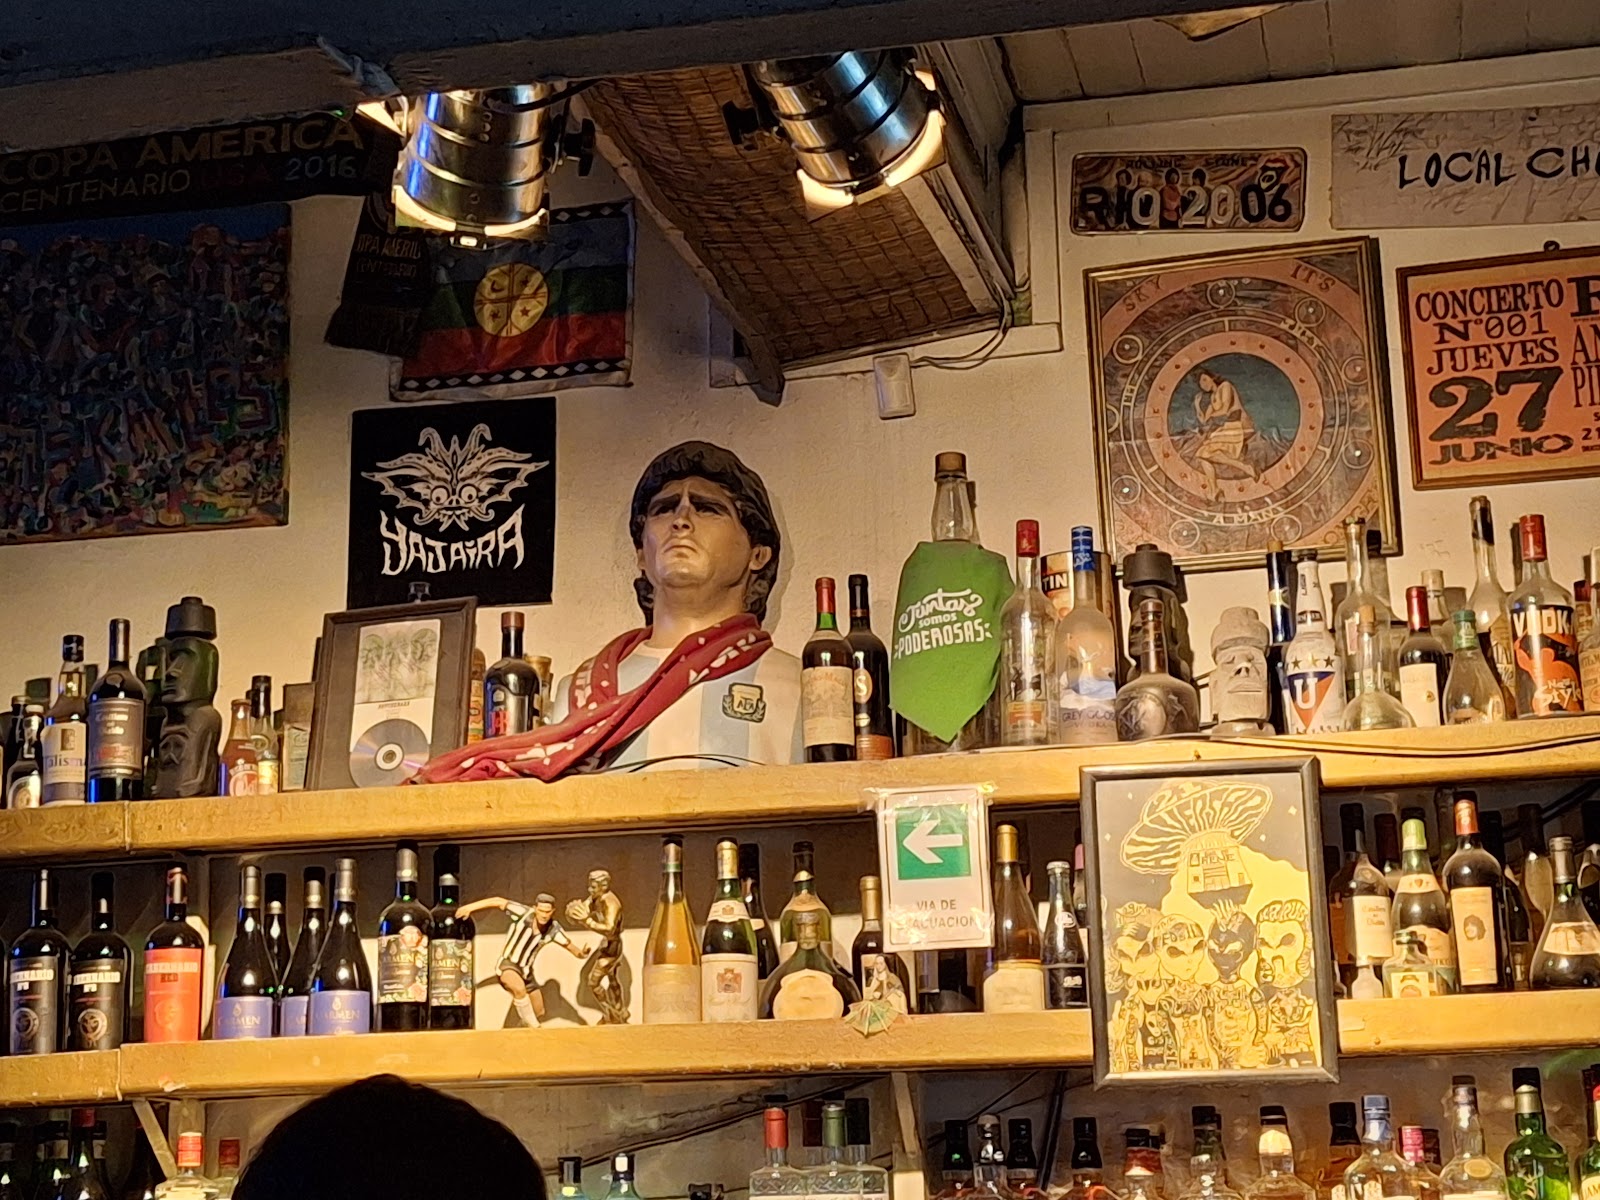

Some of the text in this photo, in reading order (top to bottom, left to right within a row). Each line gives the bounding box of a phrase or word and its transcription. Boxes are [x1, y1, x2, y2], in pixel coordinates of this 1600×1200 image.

[0, 118, 364, 185] COPA AMERICA
[284, 154, 357, 182] 2016
[1398, 150, 1517, 189] LOCAL
[0, 169, 190, 213] CENTENARIO
[1179, 184, 1293, 227] 2006
[1124, 274, 1162, 312] SKY
[1415, 278, 1564, 322] CONCIERTO
[1427, 337, 1559, 375] JUEVES
[1428, 367, 1564, 442] 27
[1571, 365, 1600, 408] PI
[1429, 433, 1575, 466] JUNIO
[379, 503, 526, 576] YAJAIRA
[898, 588, 984, 633] Juntas
[917, 611, 958, 629] somos
[898, 618, 985, 660] PODEROSAS
[916, 899, 957, 911] VIA DE
